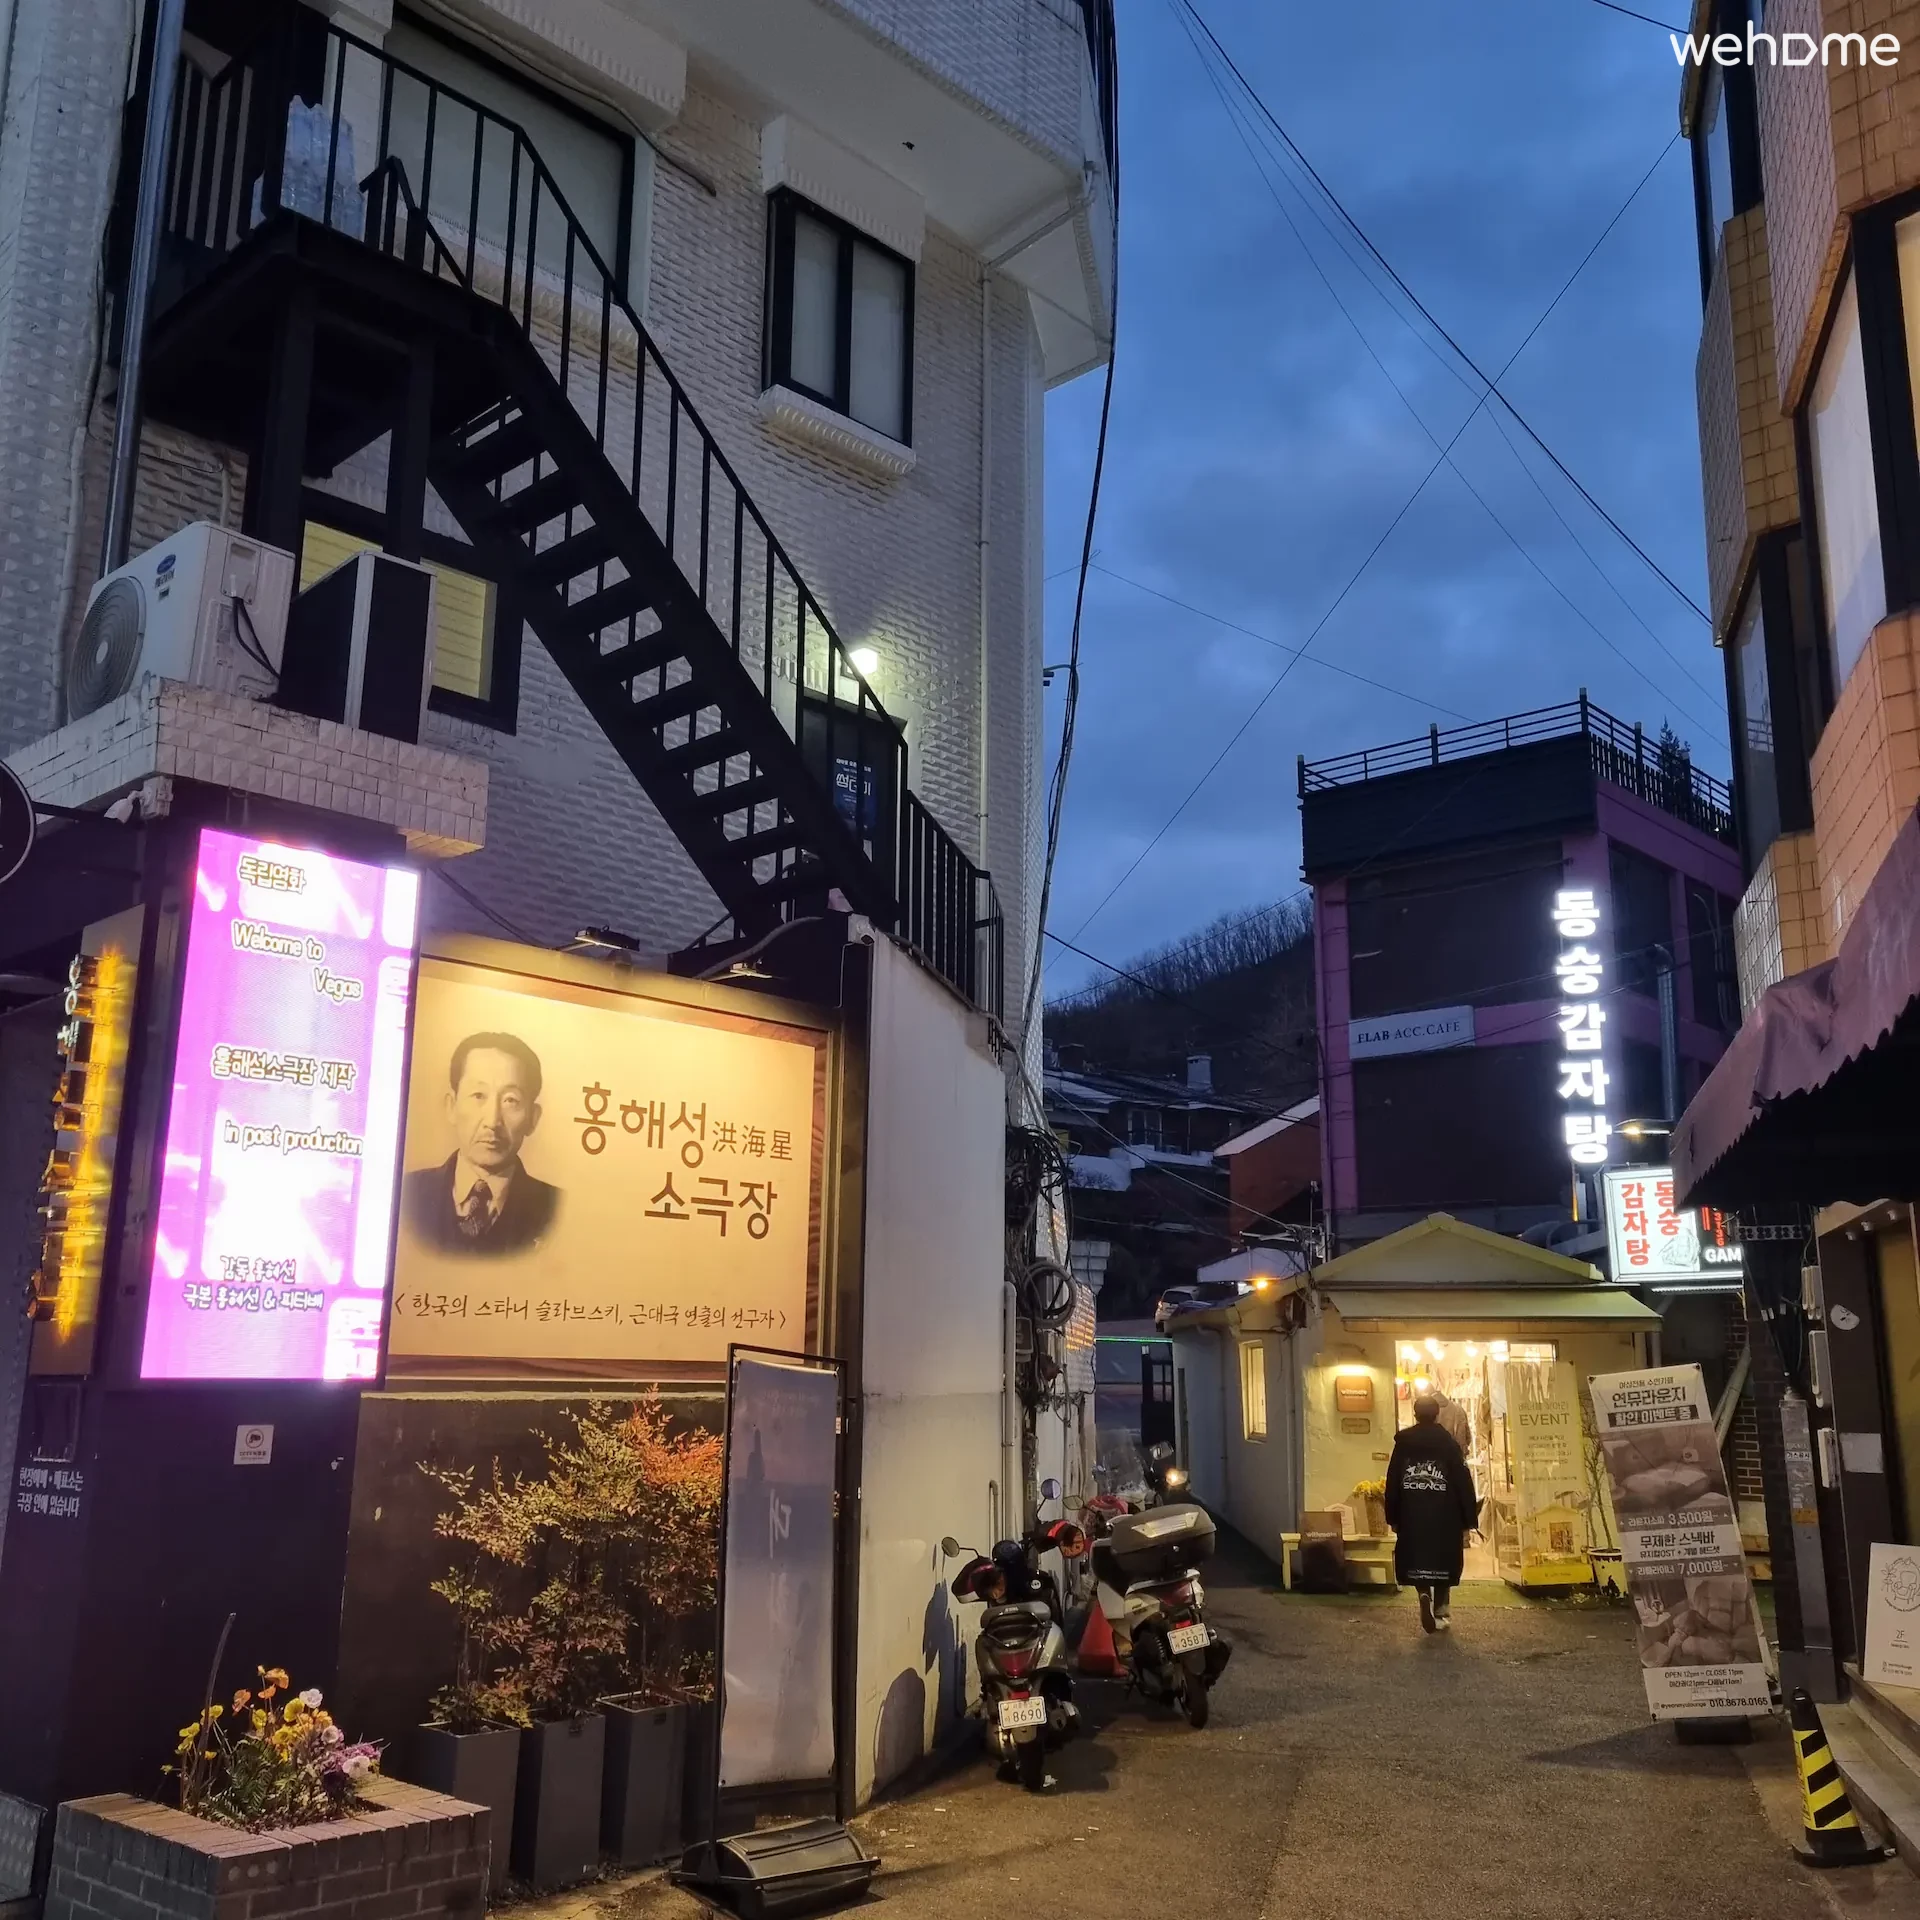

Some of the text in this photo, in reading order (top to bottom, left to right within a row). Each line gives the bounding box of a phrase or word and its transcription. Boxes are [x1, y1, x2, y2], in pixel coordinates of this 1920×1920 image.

[239, 855, 307, 895] 독립영화
[233, 921, 324, 961] Welcome to
[313, 966, 362, 1002] Vegas
[1553, 890, 1612, 1163] 동숭감자탕
[213, 1045, 357, 1091] 홍해성소극장 제작
[224, 1120, 364, 1156] in post production
[573, 1081, 793, 1169] 홍해성 洪海星
[644, 1171, 778, 1240] 소극장
[1621, 1182, 1651, 1266] 감자탕
[220, 1255, 250, 1283] 감독
[1705, 1247, 1741, 1263] GAM
[182, 1282, 213, 1310] 극본
[263, 1286, 277, 1310] &
[413, 1293, 467, 1317] 한국의
[474, 1296, 529, 1320] 스타니
[535, 1299, 623, 1326] 슬라브스키,
[685, 1305, 726, 1328] 연출의
[731, 1307, 775, 1330] 선구자
[1612, 1386, 1686, 1408] 연뮤라운지
[1519, 1412, 1571, 1427] EVENT
[1615, 1405, 1691, 1426] 할인 이벤트 중
[1403, 1481, 1446, 1491] SCIENCE
[17, 1491, 80, 1518] 극장 안에 있습니다
[1640, 1530, 1716, 1548] 무제한 스낵바
[1180, 1633, 1205, 1647] 3587
[1896, 1630, 1905, 1639] 2F
[1012, 1708, 1042, 1723] 8690
[1710, 1697, 1768, 1708] 010.8678.0165
